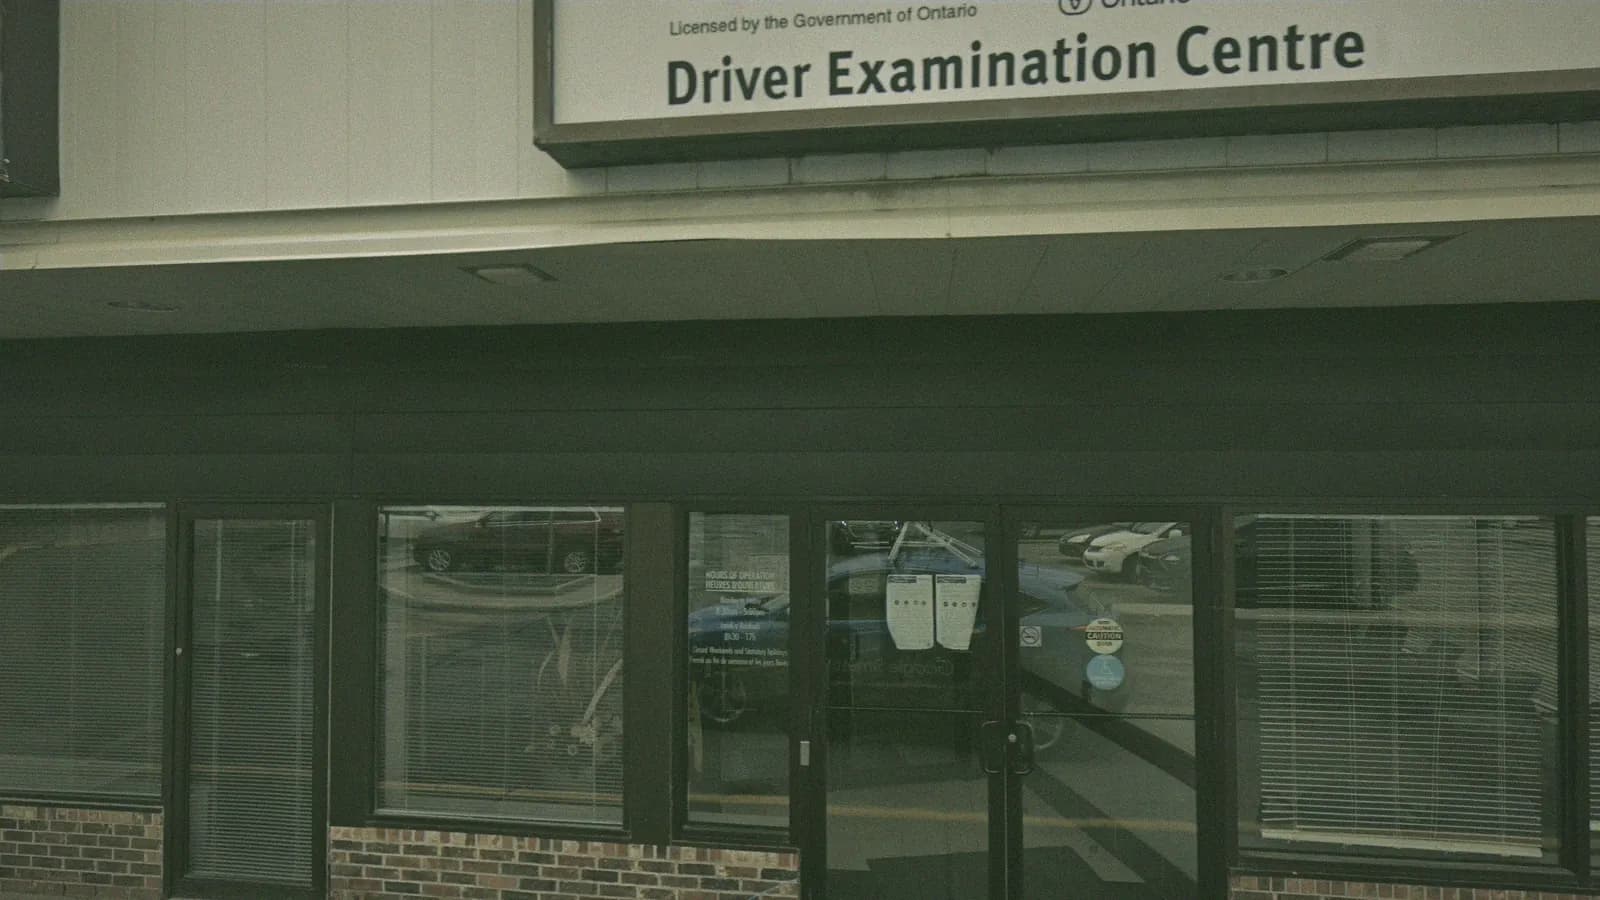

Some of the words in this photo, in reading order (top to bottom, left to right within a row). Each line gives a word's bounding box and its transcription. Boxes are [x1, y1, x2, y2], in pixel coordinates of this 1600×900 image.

[669, 16, 738, 36] Licensed
[741, 15, 760, 34] by
[764, 15, 789, 30] the
[793, 8, 893, 28] Government
[896, 7, 913, 23] of
[916, 3, 978, 21] Ontario
[668, 54, 812, 105] Driver
[829, 32, 1156, 95] Examination
[1176, 23, 1366, 76] Centre
